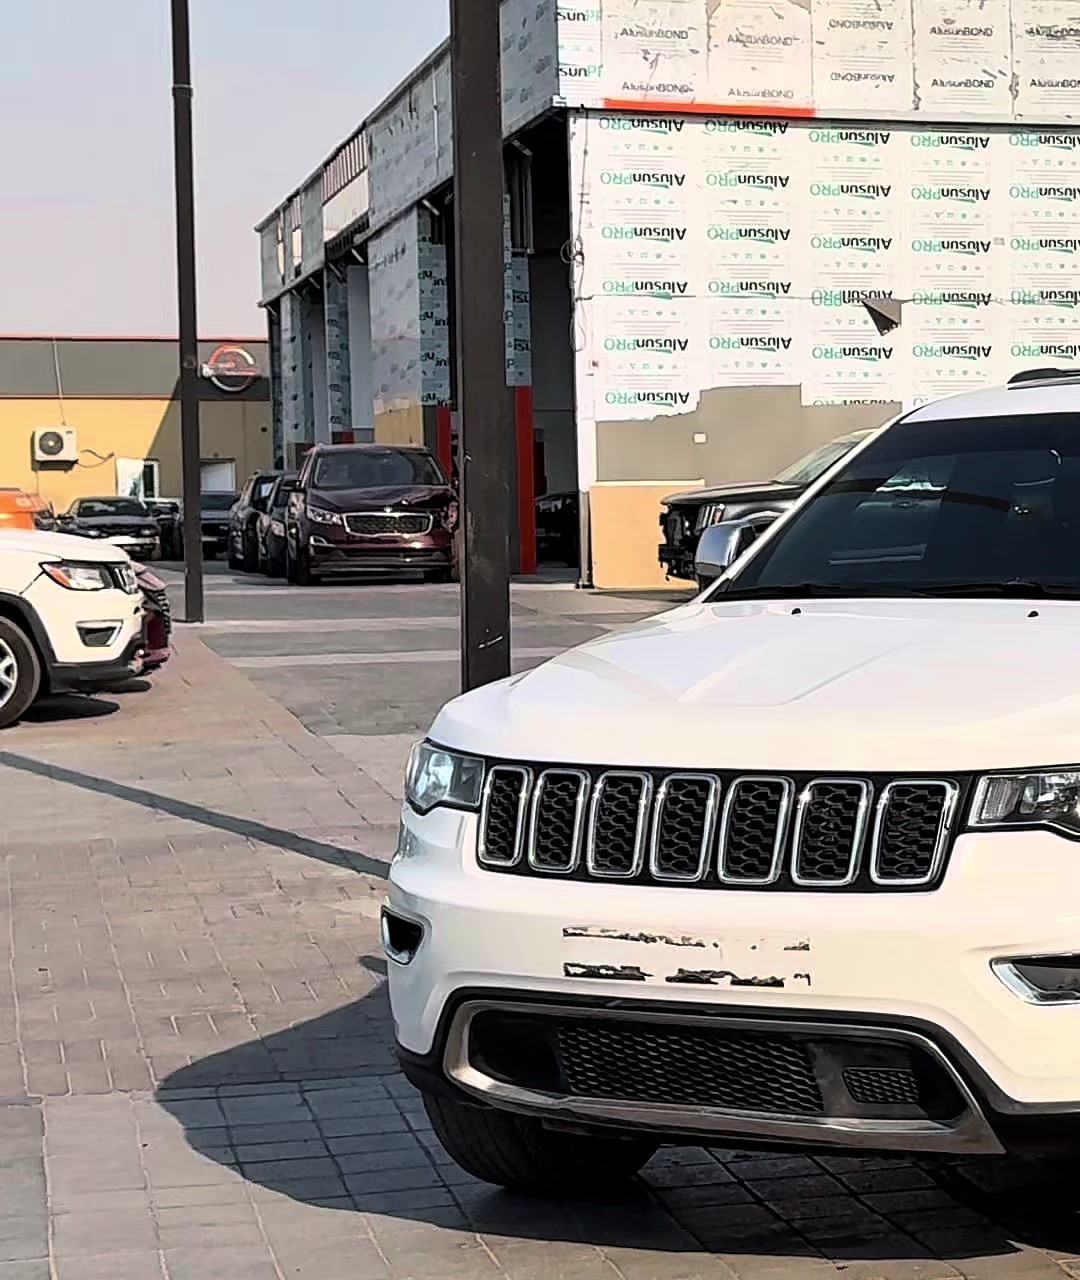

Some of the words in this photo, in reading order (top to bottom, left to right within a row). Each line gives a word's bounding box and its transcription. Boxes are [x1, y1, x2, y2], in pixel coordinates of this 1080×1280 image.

[599, 117, 685, 133] AlusunPRO
[705, 119, 789, 134] AlusunPRO
[809, 130, 890, 144] AlusunPRO
[910, 135, 990, 149] AlusunPRO
[600, 171, 686, 186] AlusunPRO
[706, 173, 790, 187] AlusunPRO
[809, 183, 891, 197] AlusunPRO
[911, 187, 991, 200] AlusunPRO
[601, 225, 687, 240] AlusunPRO
[707, 226, 791, 241] AlusunPRO
[810, 236, 892, 250] AlusunPRO
[911, 239, 991, 253] AlusunPRO
[602, 280, 688, 294] AlusunPRO
[708, 280, 792, 294] AlusunPRO
[912, 291, 992, 306] AlusunPRO
[604, 337, 689, 351] AlusunPRO
[709, 336, 792, 350] AlusunPRO
[812, 346, 893, 360] AlusunPRO
[912, 344, 992, 358] AlusunPRO
[605, 391, 690, 405] AlusunPRO
